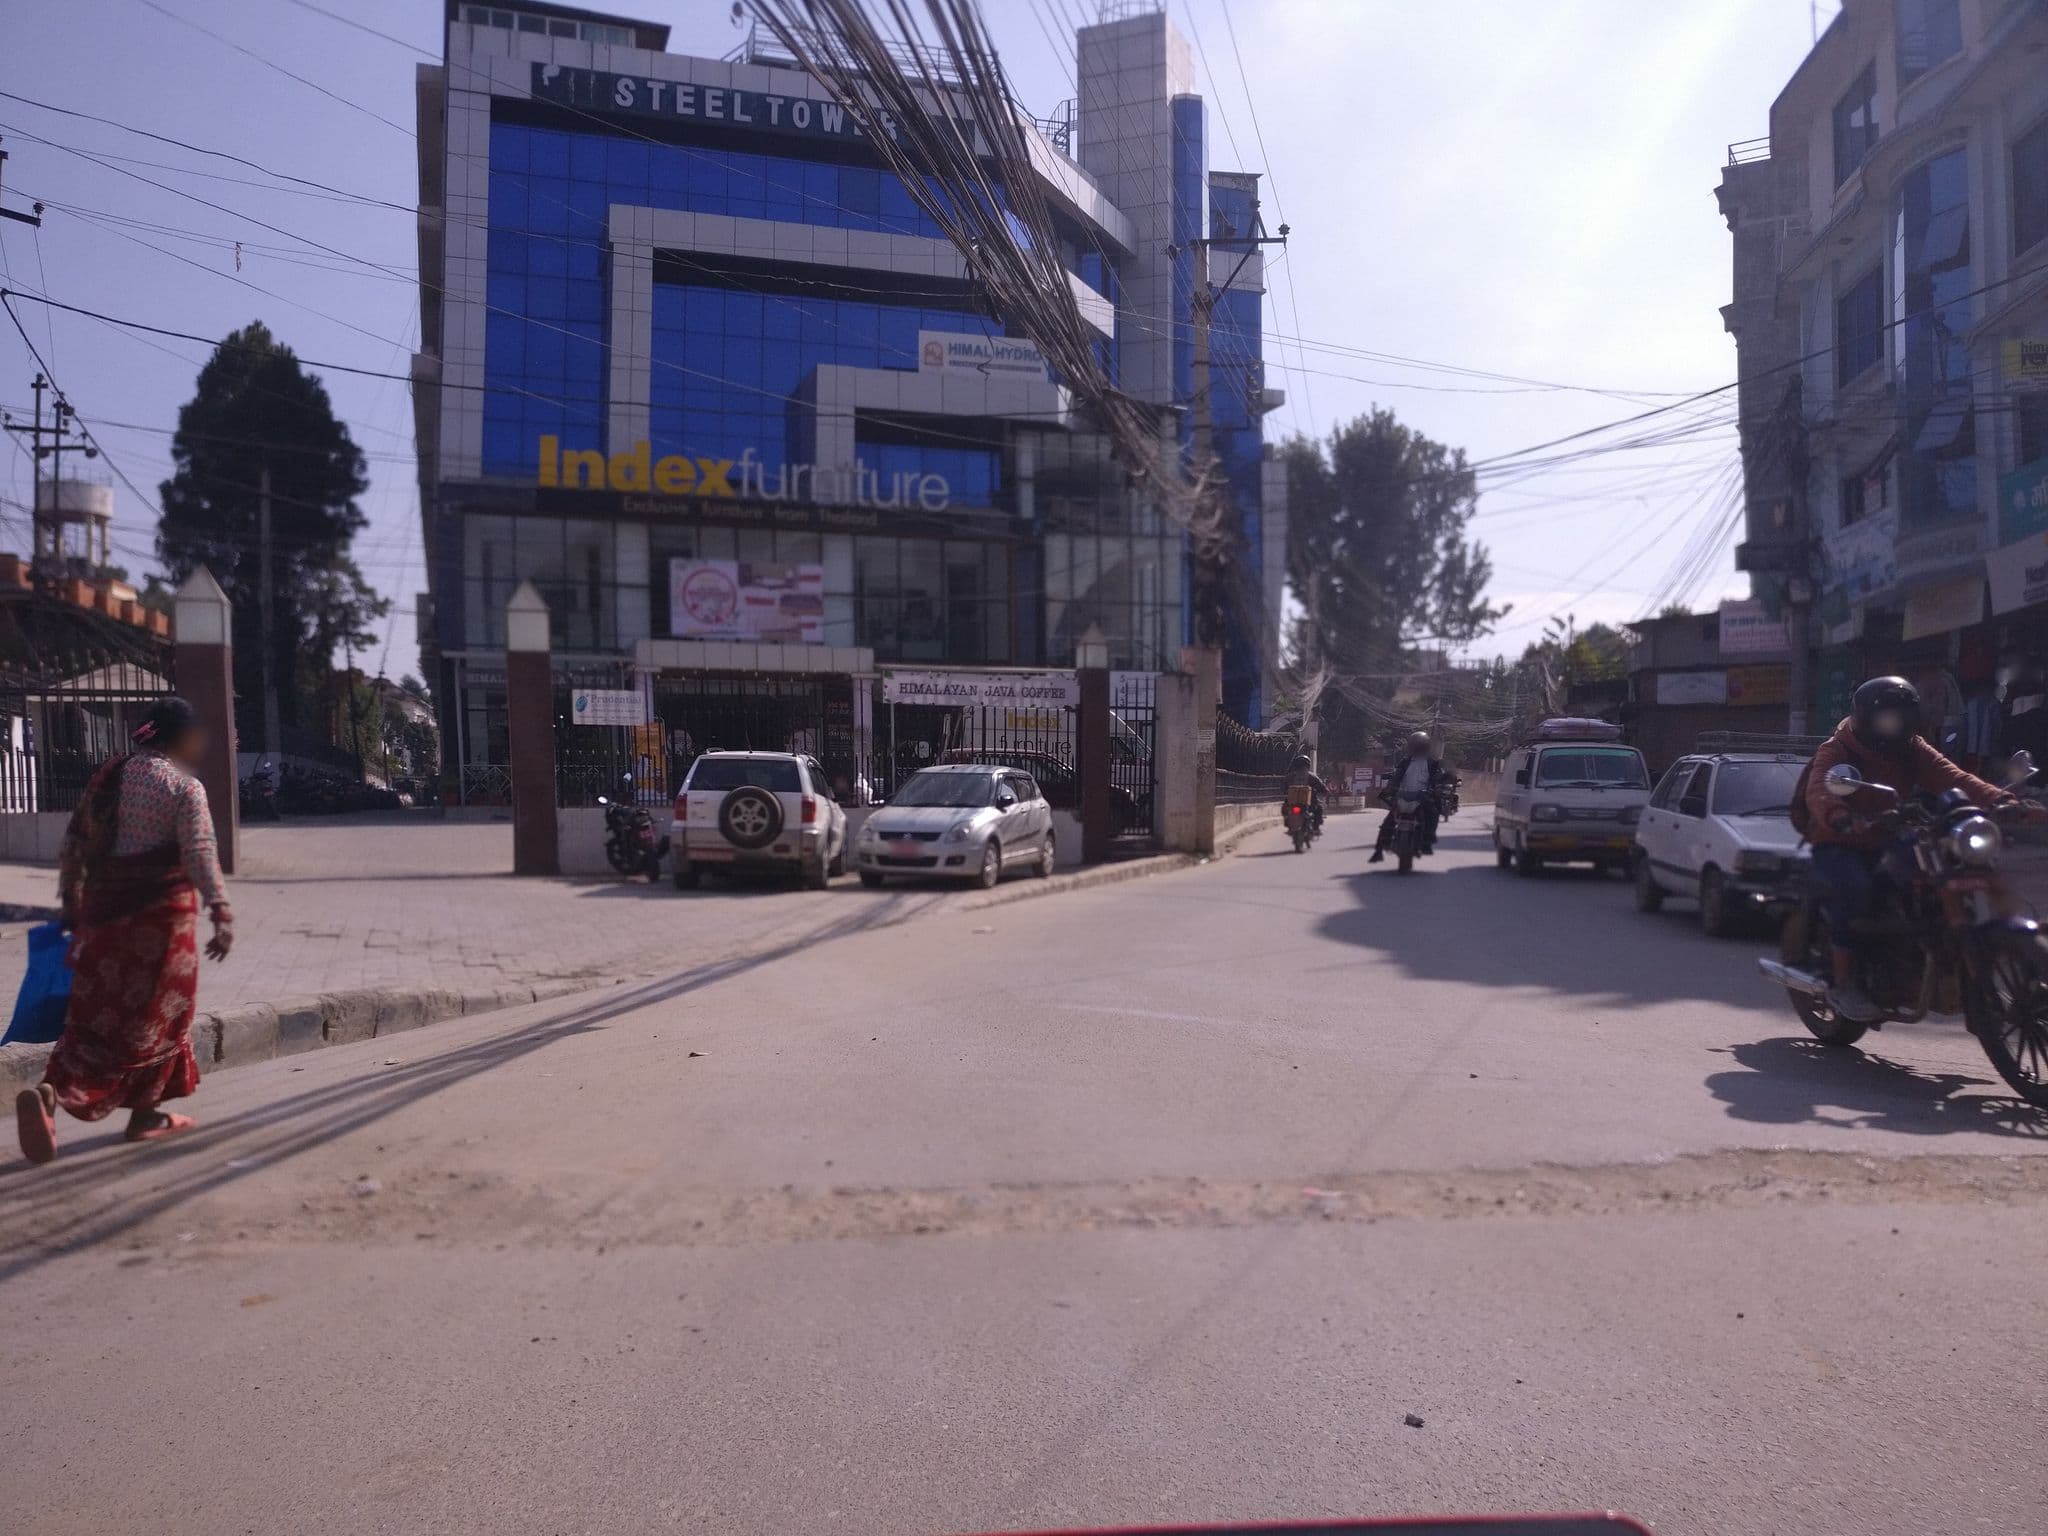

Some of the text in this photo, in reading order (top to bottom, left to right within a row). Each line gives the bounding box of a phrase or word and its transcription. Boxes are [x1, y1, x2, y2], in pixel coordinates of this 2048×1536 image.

[614, 76, 752, 123] STEEL
[948, 342, 1042, 361] HIMAL HYDRO
[538, 434, 950, 512] Index furniture
[899, 683, 1067, 699] HIMALAYAN JAVA COFFEE
[1000, 735, 1072, 755] frnture
